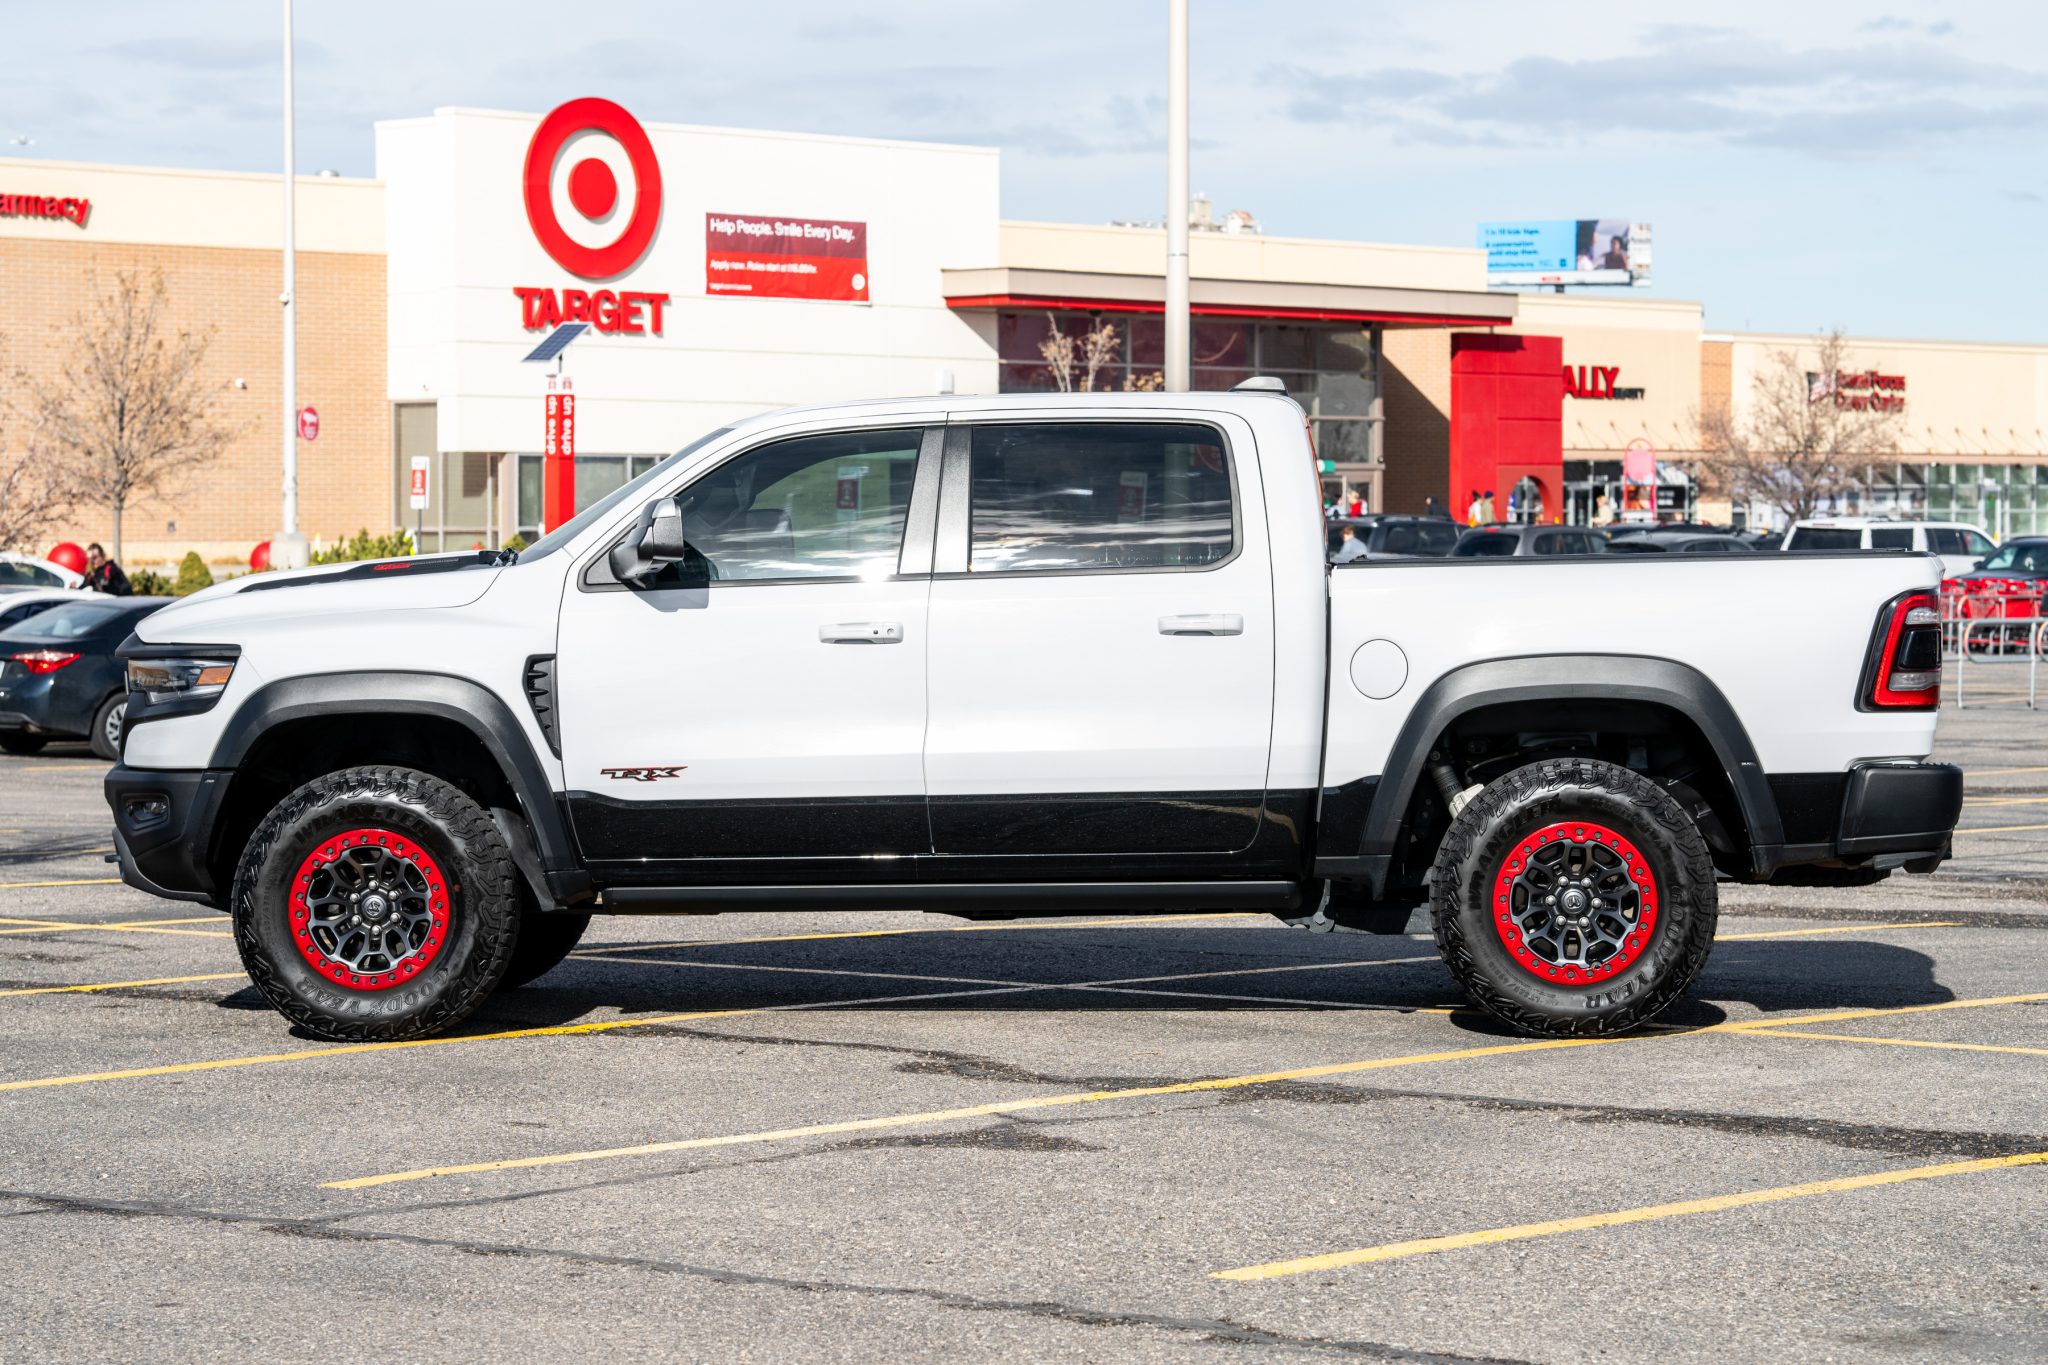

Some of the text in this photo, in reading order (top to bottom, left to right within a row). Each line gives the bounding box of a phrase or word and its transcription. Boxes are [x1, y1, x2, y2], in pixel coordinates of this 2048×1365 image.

[710, 218, 856, 243] Help People. Smile Every Day.
[513, 286, 670, 334] TARGET
[547, 396, 558, 456] drive up
[561, 396, 574, 456] drive up
[600, 766, 688, 781] TRX
[293, 803, 435, 845] WRANGLER
[1468, 793, 1563, 910] WRANGLER
[1583, 884, 1688, 1009] GOODYEAR
[295, 966, 450, 1018] GOODYEAR
